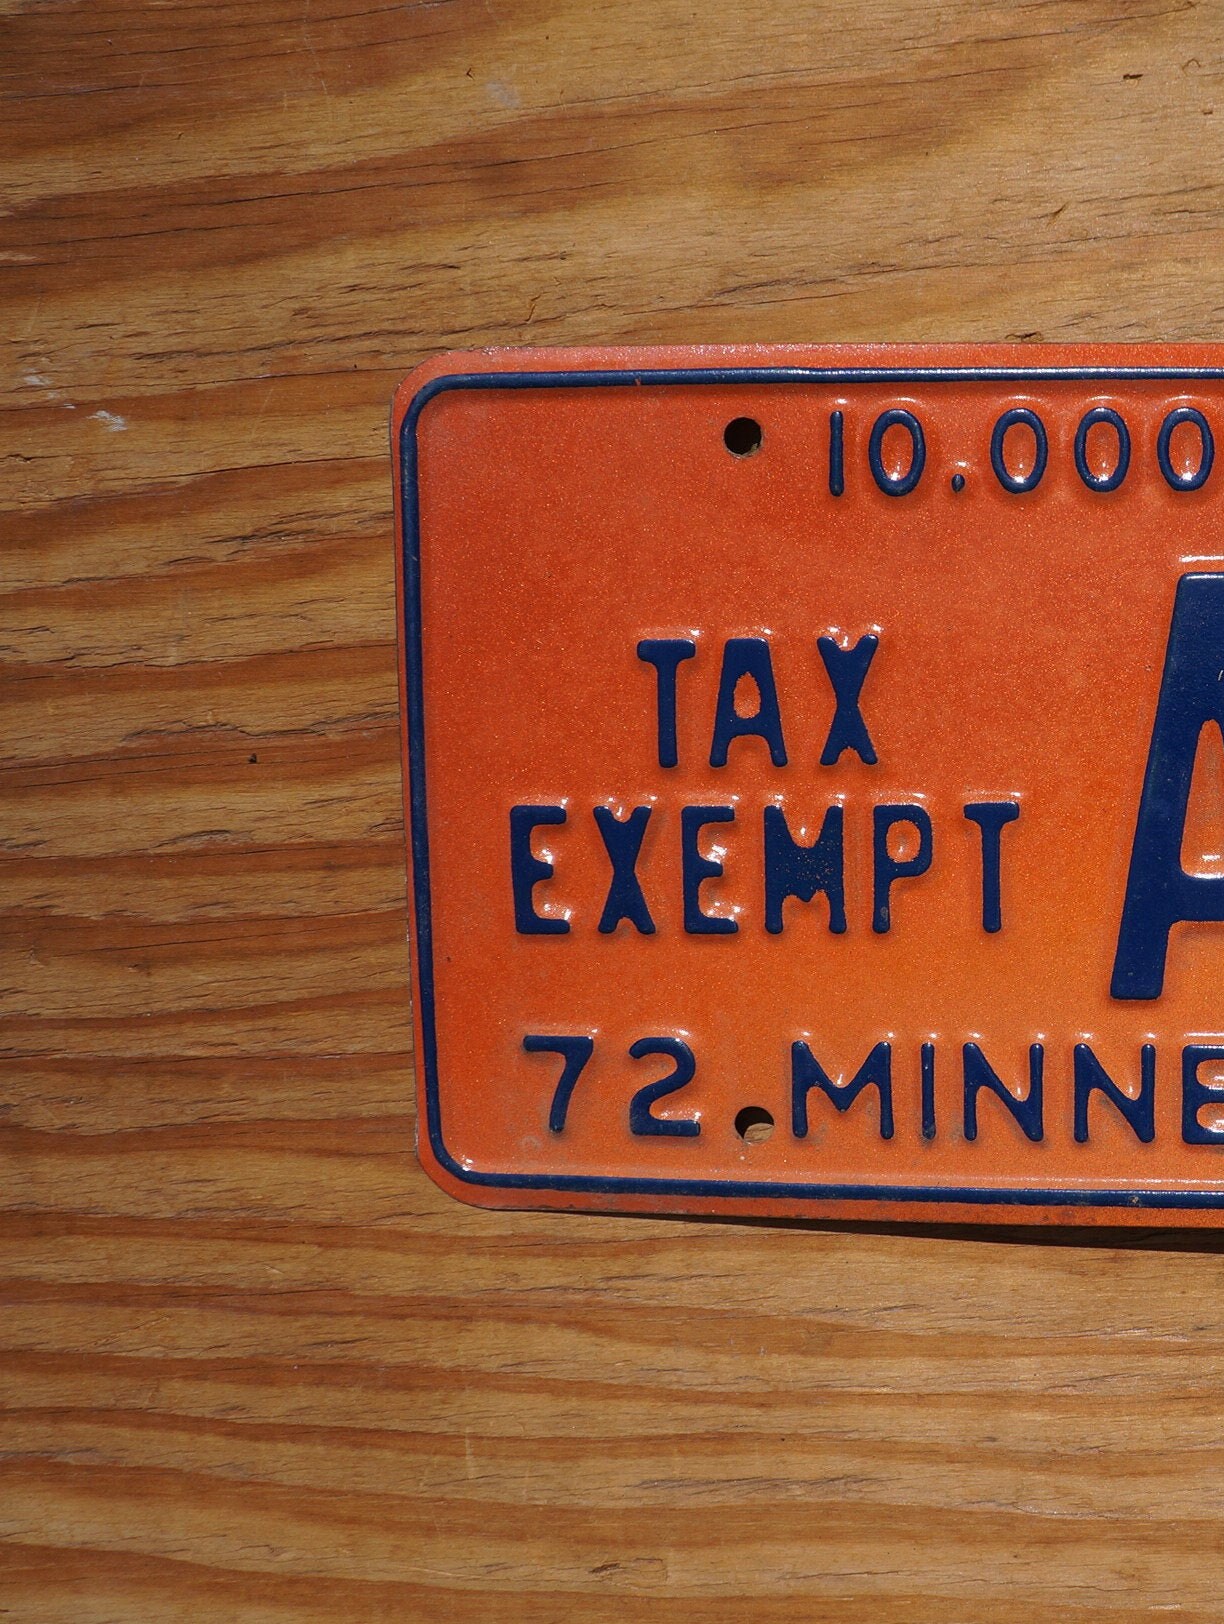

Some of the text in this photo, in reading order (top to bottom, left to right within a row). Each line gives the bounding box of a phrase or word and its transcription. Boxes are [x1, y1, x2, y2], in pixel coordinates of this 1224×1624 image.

[637, 634, 879, 768] TAX
[510, 801, 1019, 935] EXEMPT
[523, 1035, 700, 1137] 72
